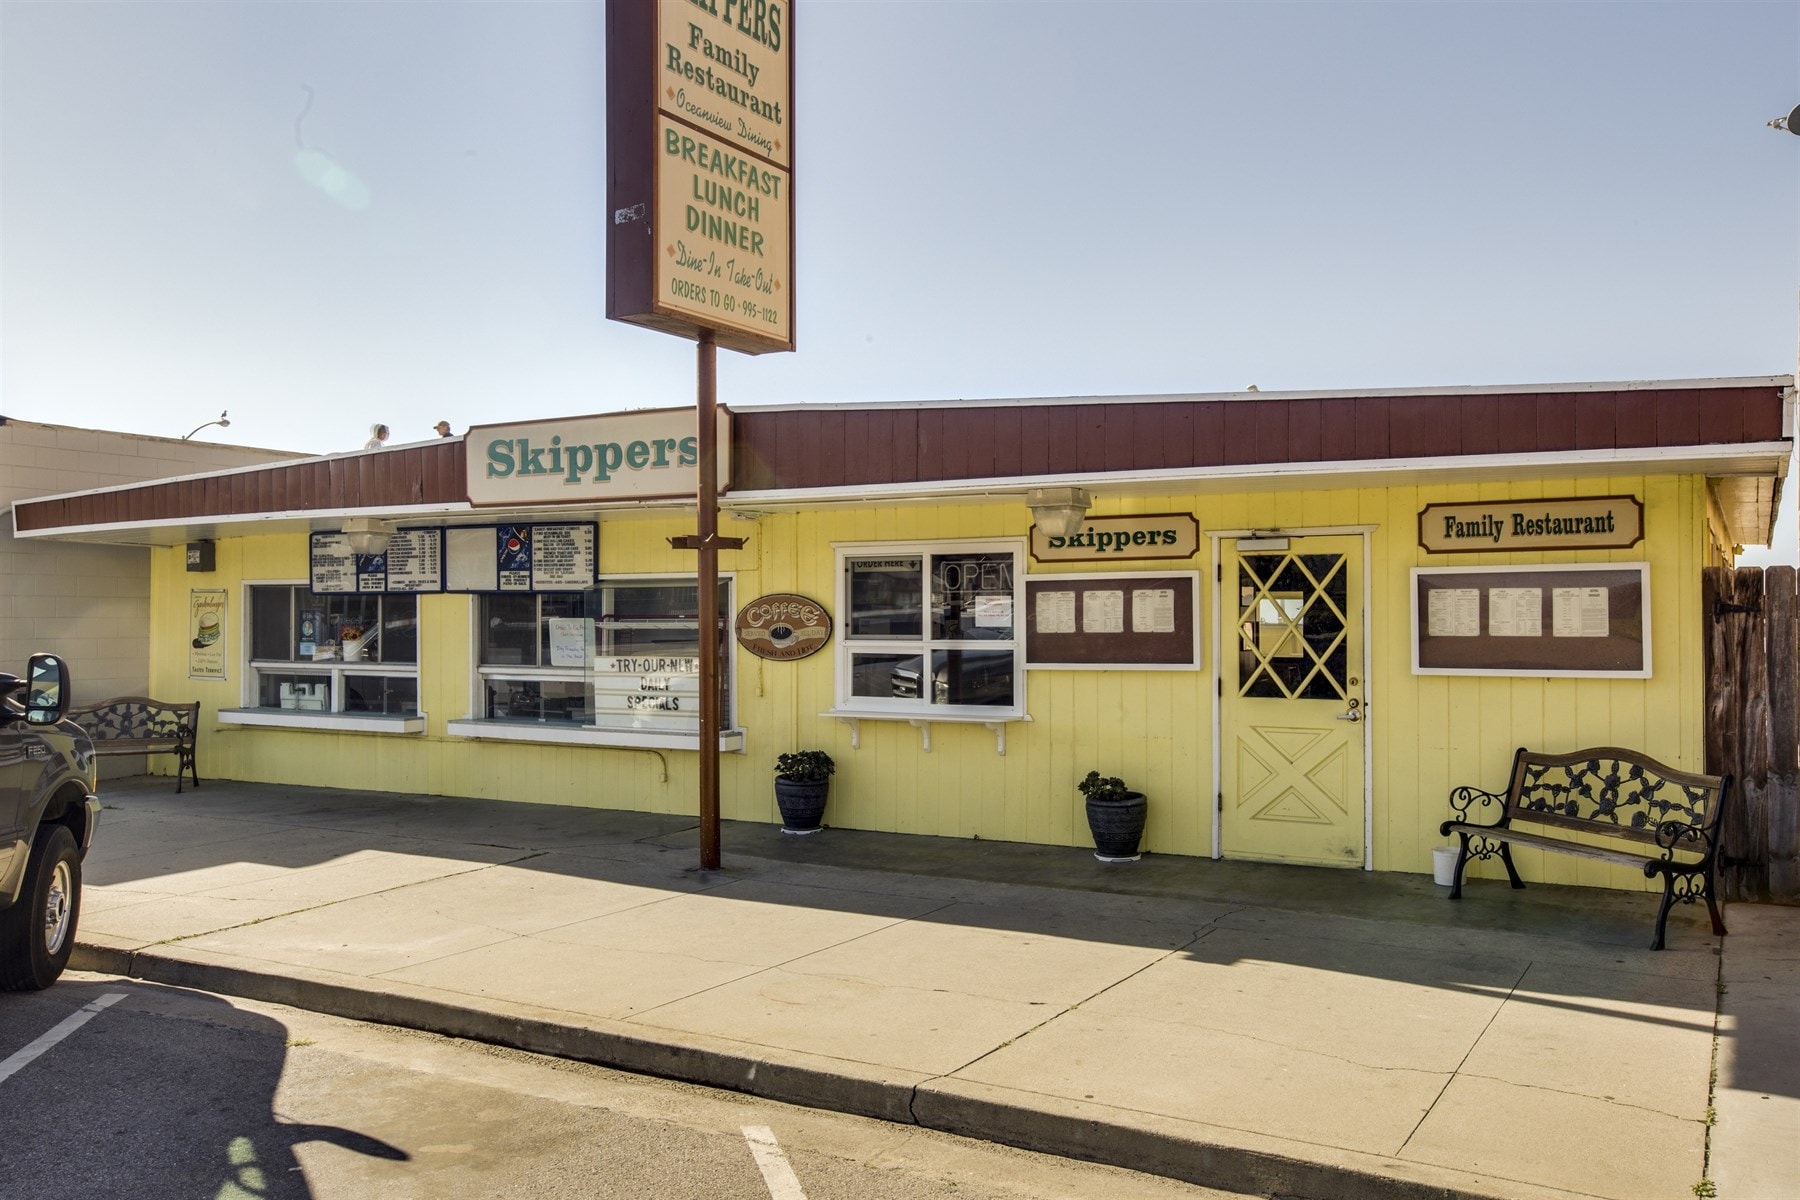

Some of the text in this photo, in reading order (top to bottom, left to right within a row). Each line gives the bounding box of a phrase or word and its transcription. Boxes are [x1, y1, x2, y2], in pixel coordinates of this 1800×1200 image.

[688, 22, 760, 87] Family
[666, 43, 782, 125] Restaurant
[676, 88, 772, 157] Oceanview Dining
[665, 128, 781, 199] BREAKFAST
[693, 174, 760, 222] LUNCH
[686, 204, 765, 257] DINNER
[675, 240, 774, 295] Dine-In Take-Out
[671, 277, 778, 324] ORDERS TO GO 995-1122
[486, 435, 698, 485] Skippers
[1444, 510, 1615, 543] Family Restaurant
[943, 564, 1014, 590] OPEN
[753, 643, 777, 657] FRESH
[797, 643, 814, 655] HOT
